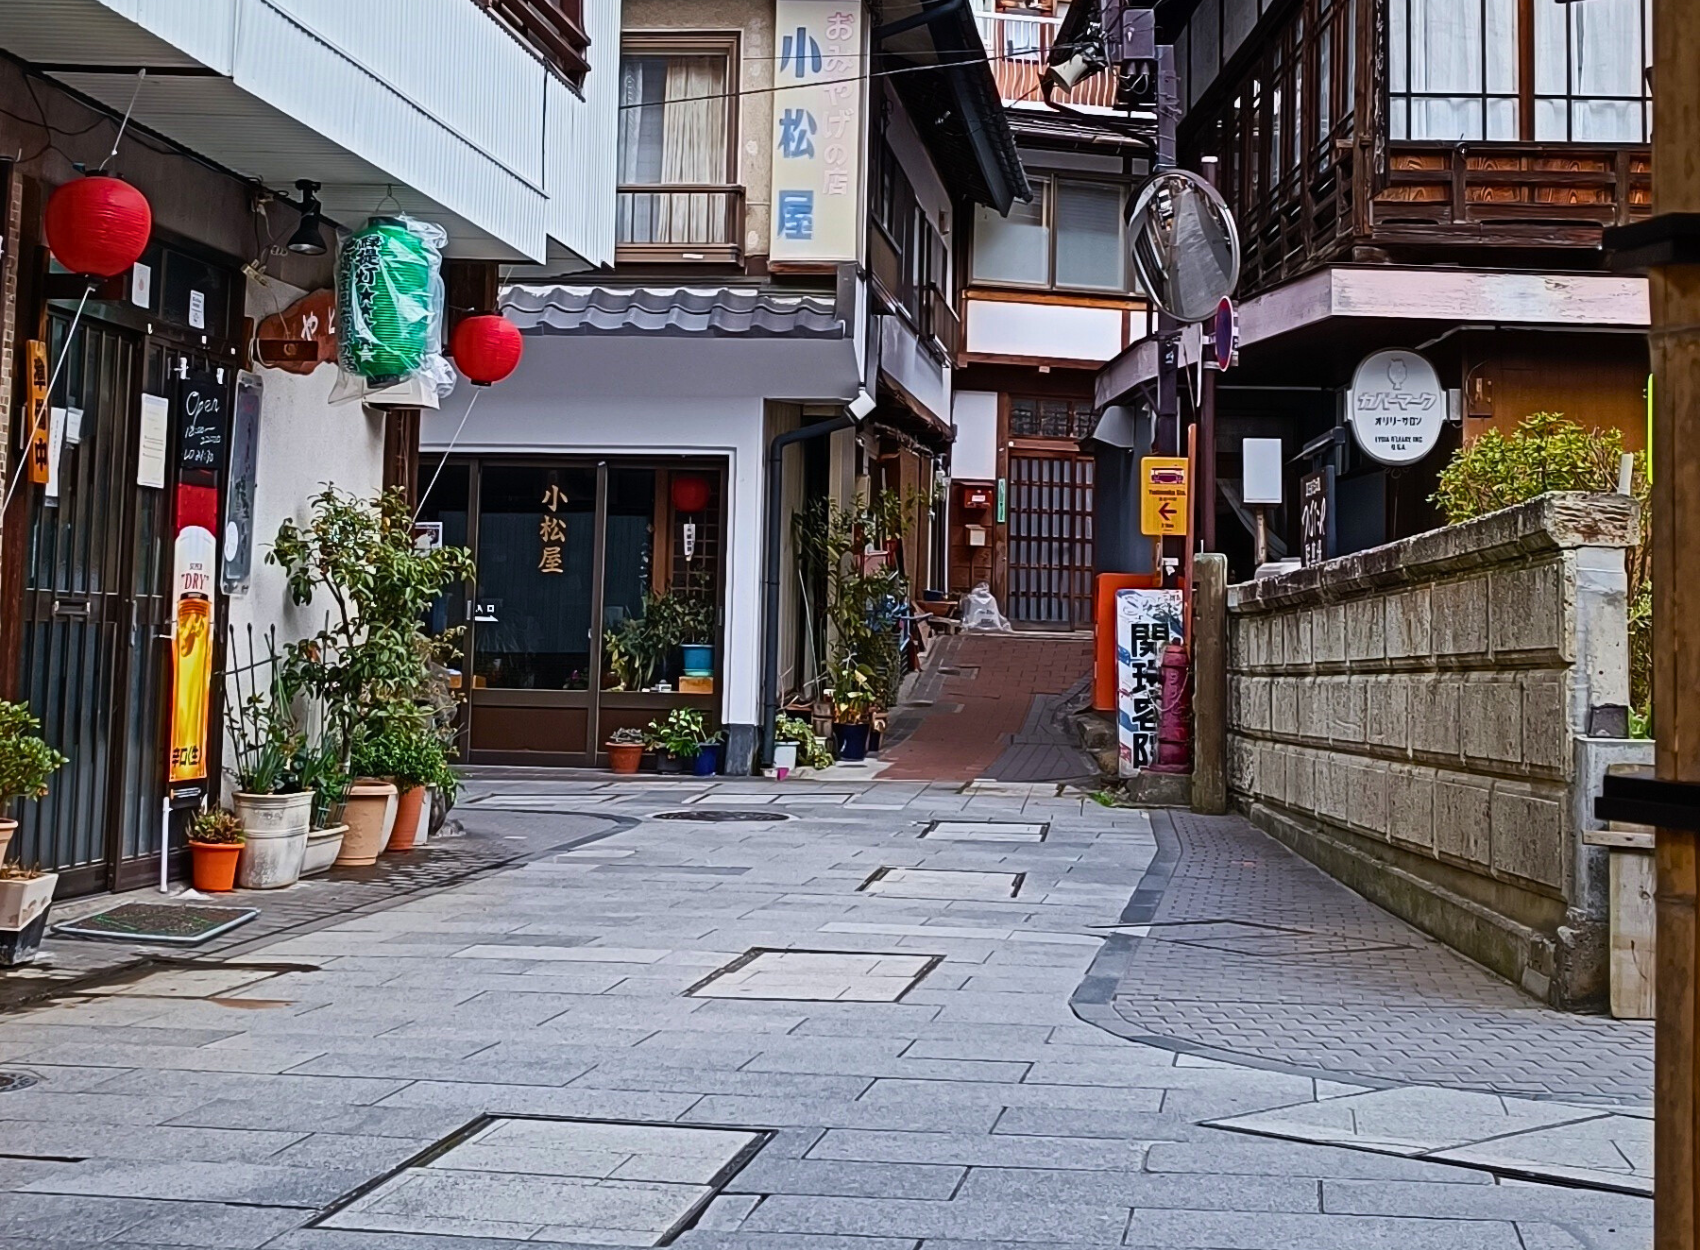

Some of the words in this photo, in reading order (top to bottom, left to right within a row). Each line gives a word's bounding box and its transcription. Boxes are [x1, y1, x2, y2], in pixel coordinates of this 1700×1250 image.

[777, 26, 823, 240] 小松屋
[821, 12, 855, 196] おみやげの店
[186, 391, 220, 426] Open
[1357, 392, 1437, 411] カバーマーク
[537, 484, 568, 573] 小松屋
